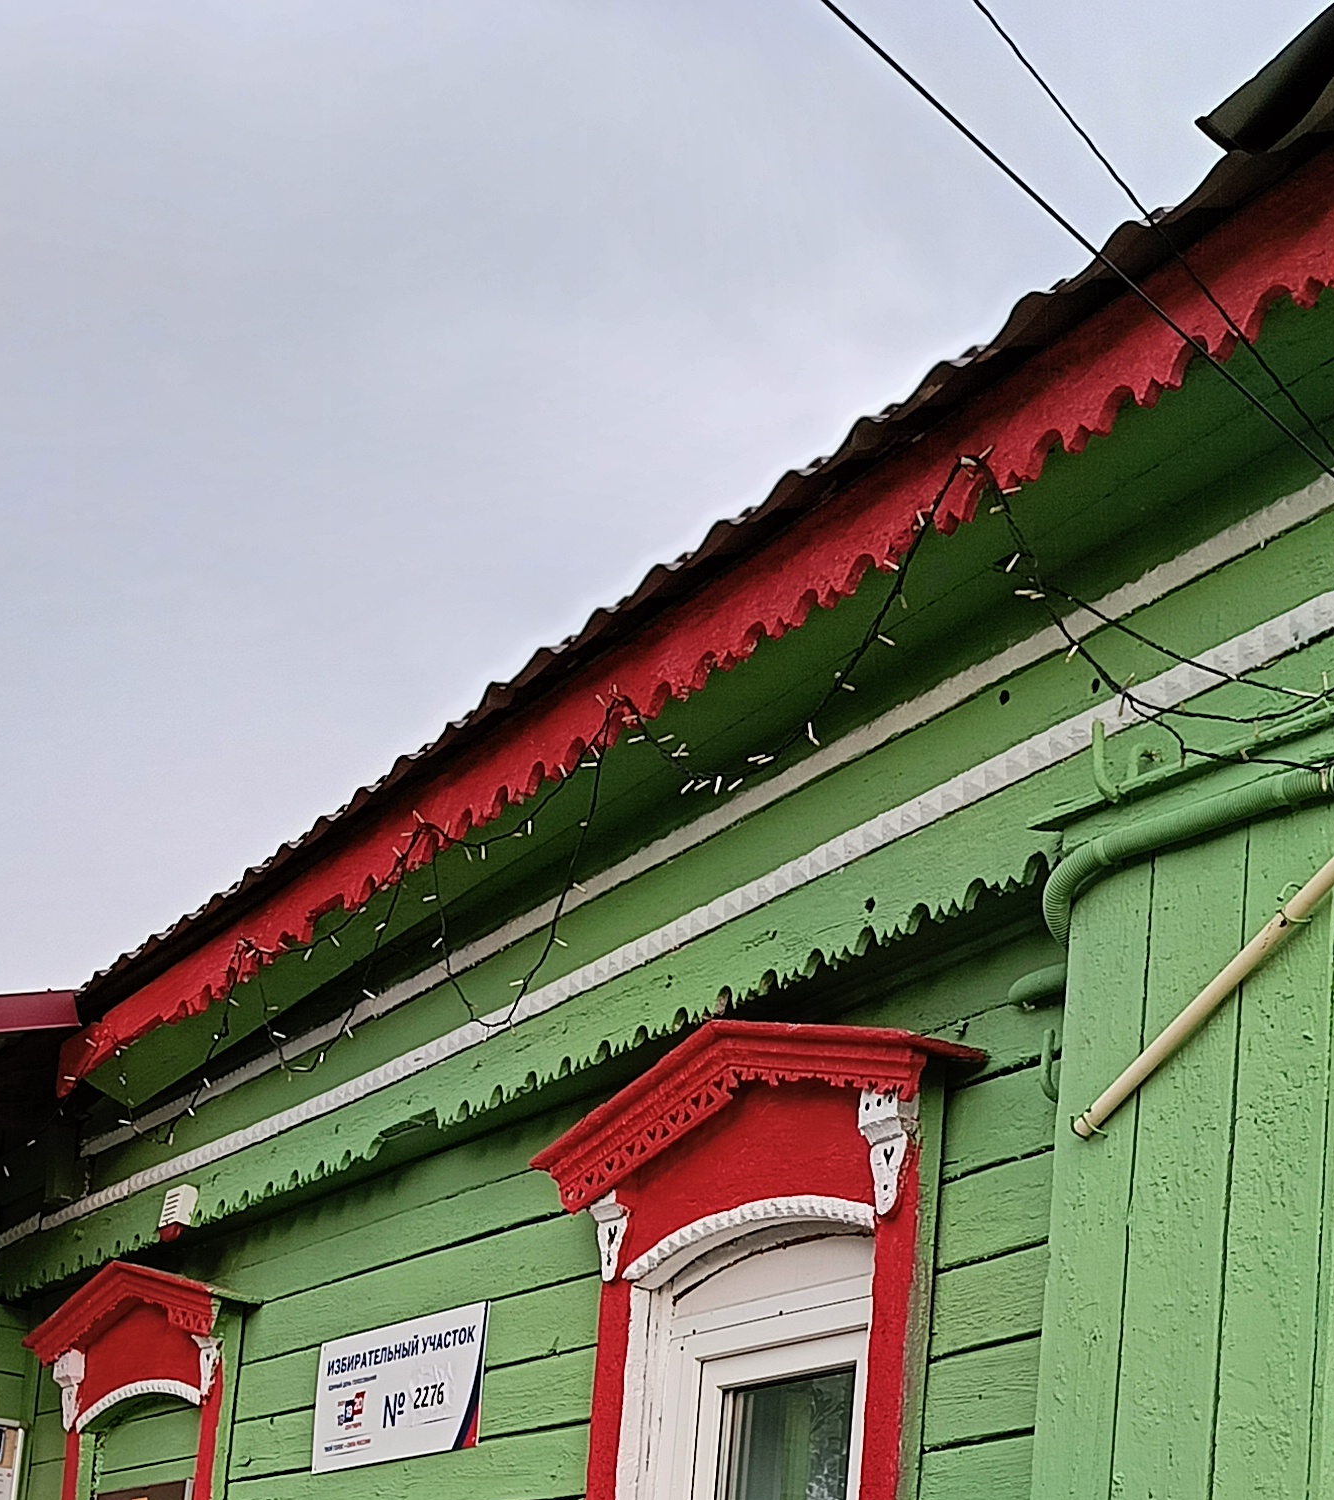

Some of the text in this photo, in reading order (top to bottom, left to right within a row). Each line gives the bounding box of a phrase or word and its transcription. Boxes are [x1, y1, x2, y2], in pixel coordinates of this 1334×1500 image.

[327, 1325, 476, 1377] ИЗБИРАТЕЛЬНЫЙ УЧАСТОК
[353, 1397, 363, 1411] 20
[382, 1382, 445, 1429] № 2276
